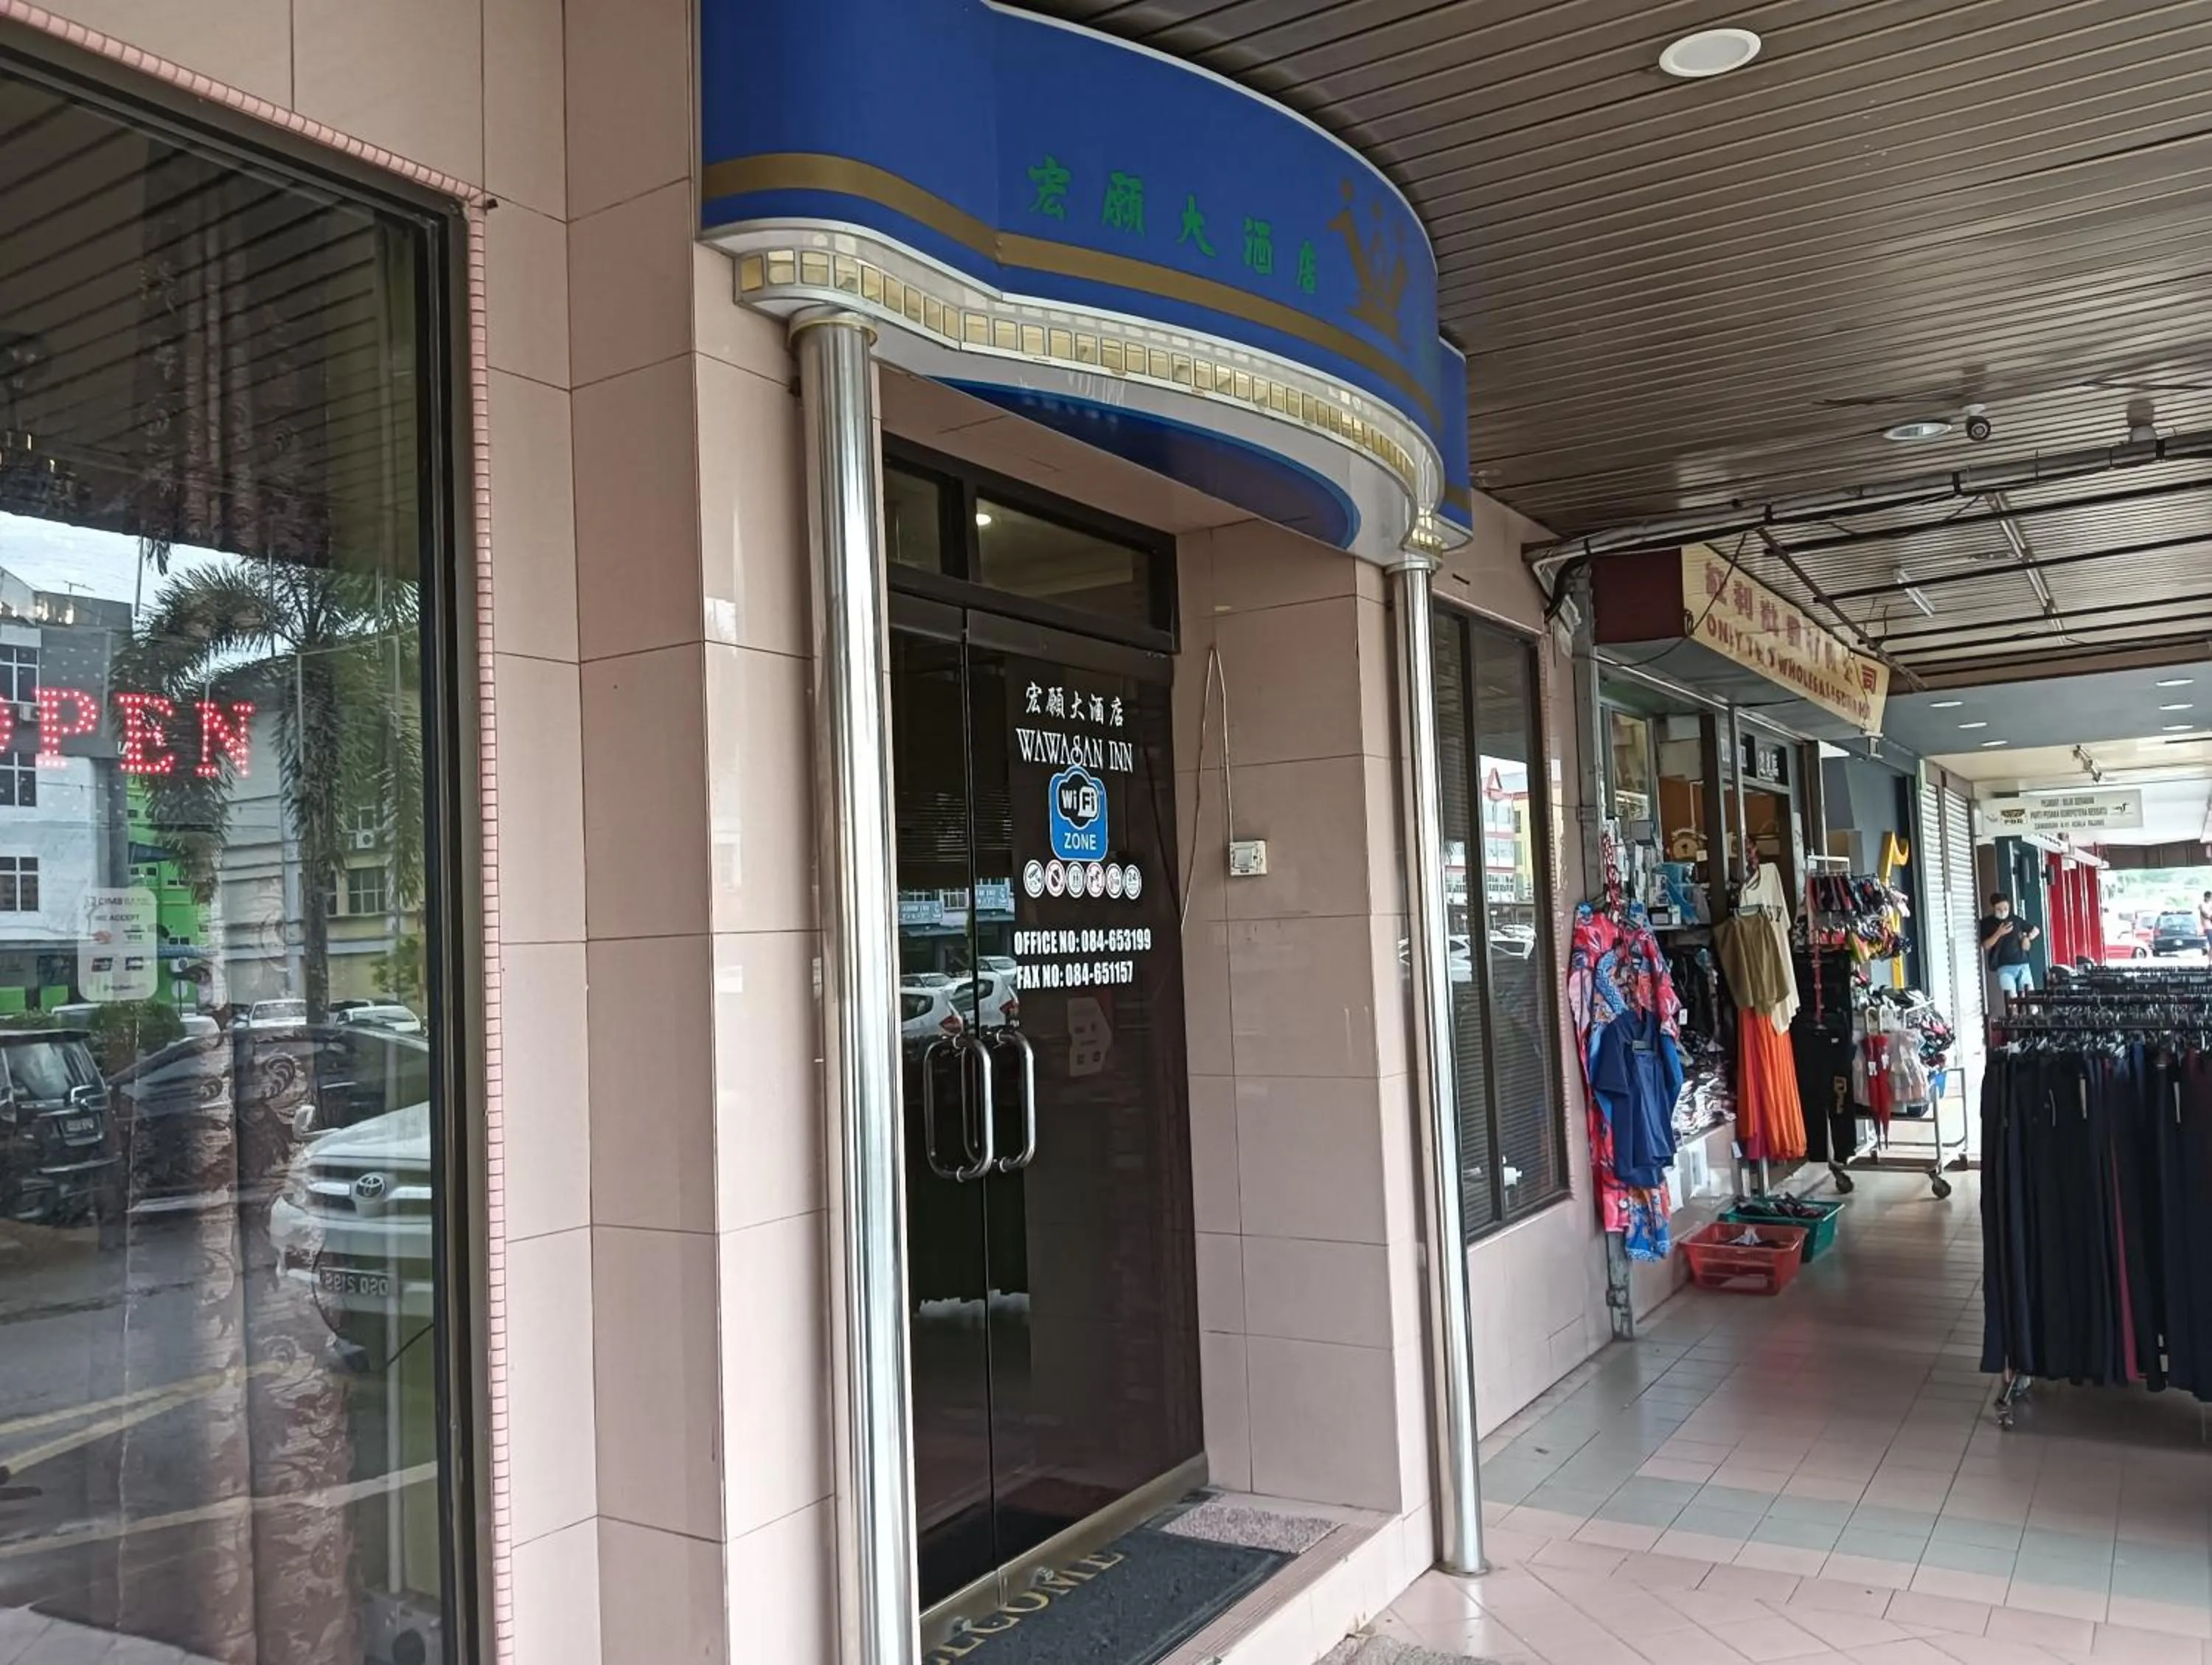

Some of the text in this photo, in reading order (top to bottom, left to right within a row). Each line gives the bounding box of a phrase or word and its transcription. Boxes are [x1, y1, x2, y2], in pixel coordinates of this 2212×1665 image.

[1015, 728, 1133, 773] WAWASAN INN
[1064, 832, 1097, 850] ZONE
[1014, 928, 1151, 955] OFFICE NO: 084-653199
[1016, 960, 1133, 990] FAX NO: 084-651157
